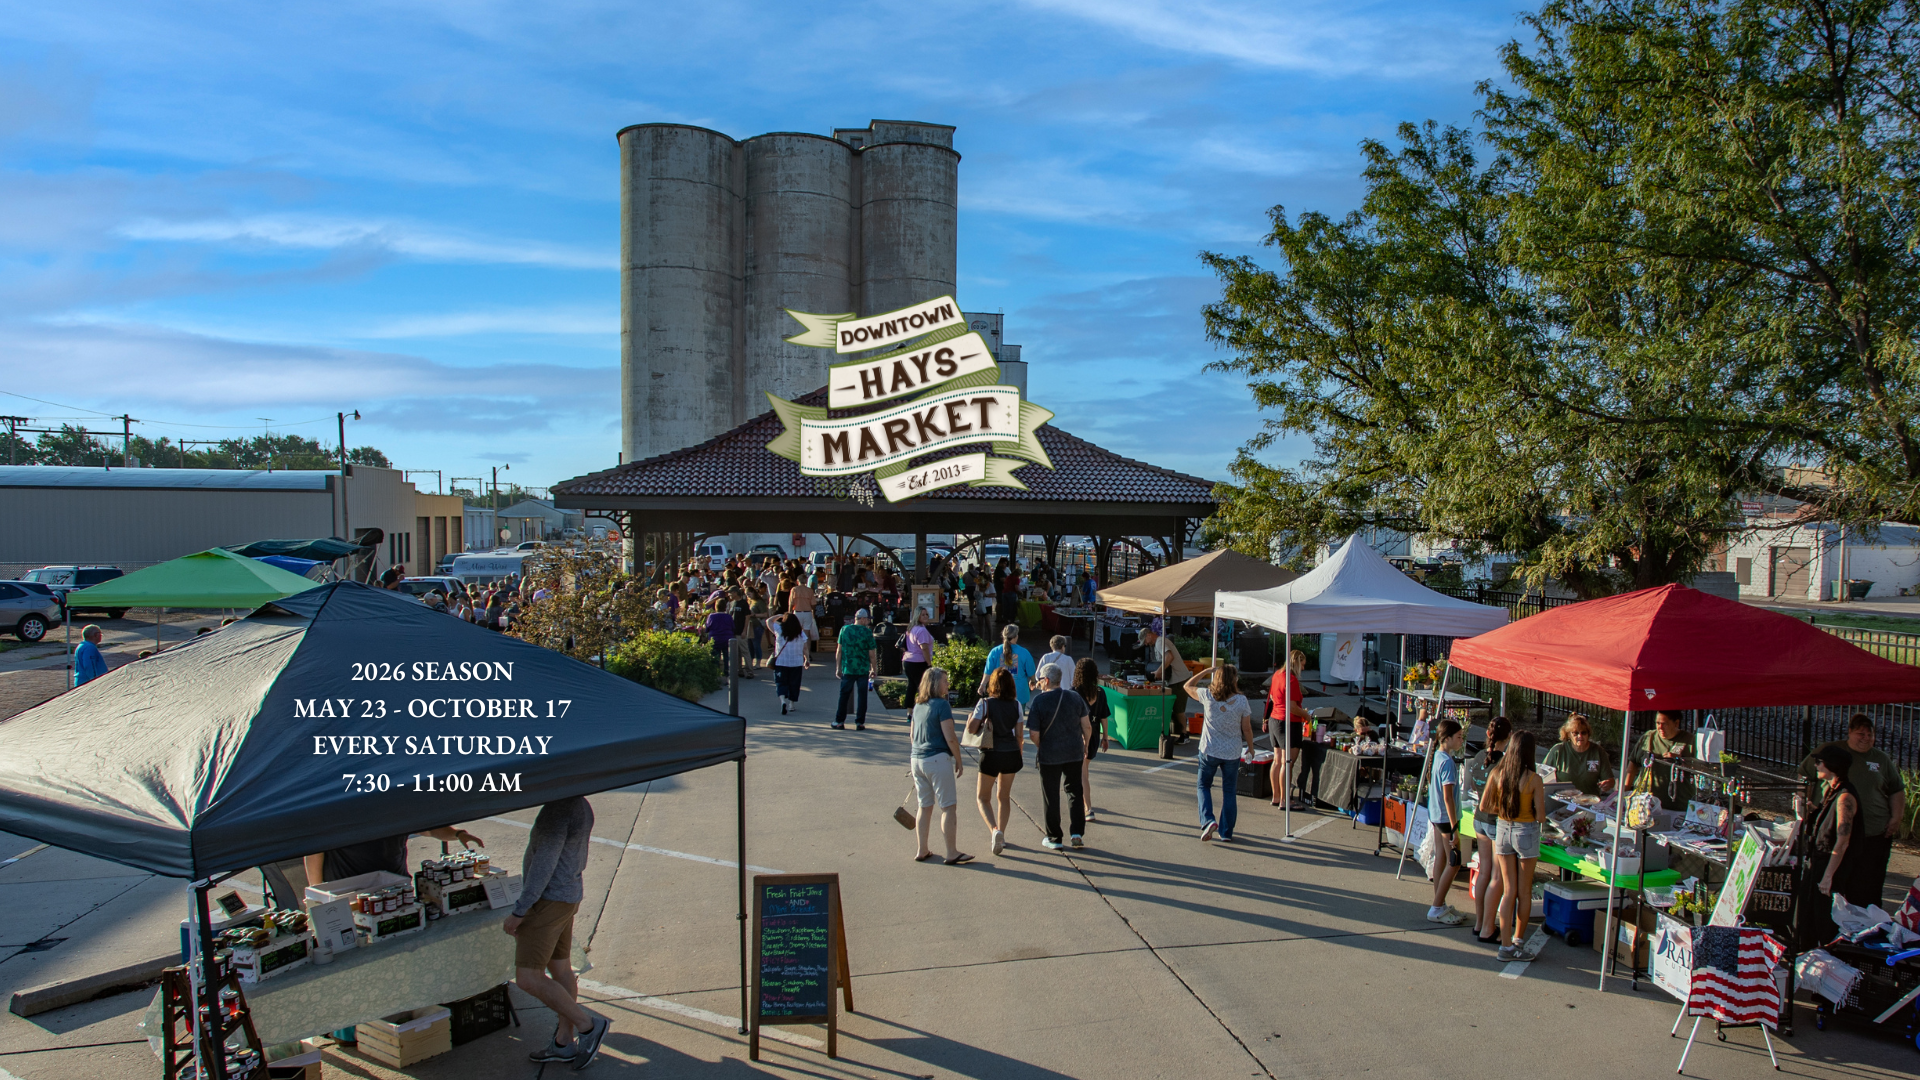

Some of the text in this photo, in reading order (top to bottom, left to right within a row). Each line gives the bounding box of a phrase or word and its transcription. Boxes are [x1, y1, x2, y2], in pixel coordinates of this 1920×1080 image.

[1754, 870, 1792, 891] MAMA
[766, 887, 786, 899] Fresh
[790, 888, 806, 898] Fruit
[1753, 892, 1791, 912] TRIED
[1666, 940, 1692, 970] RA
[1664, 960, 1688, 977] CUTL
